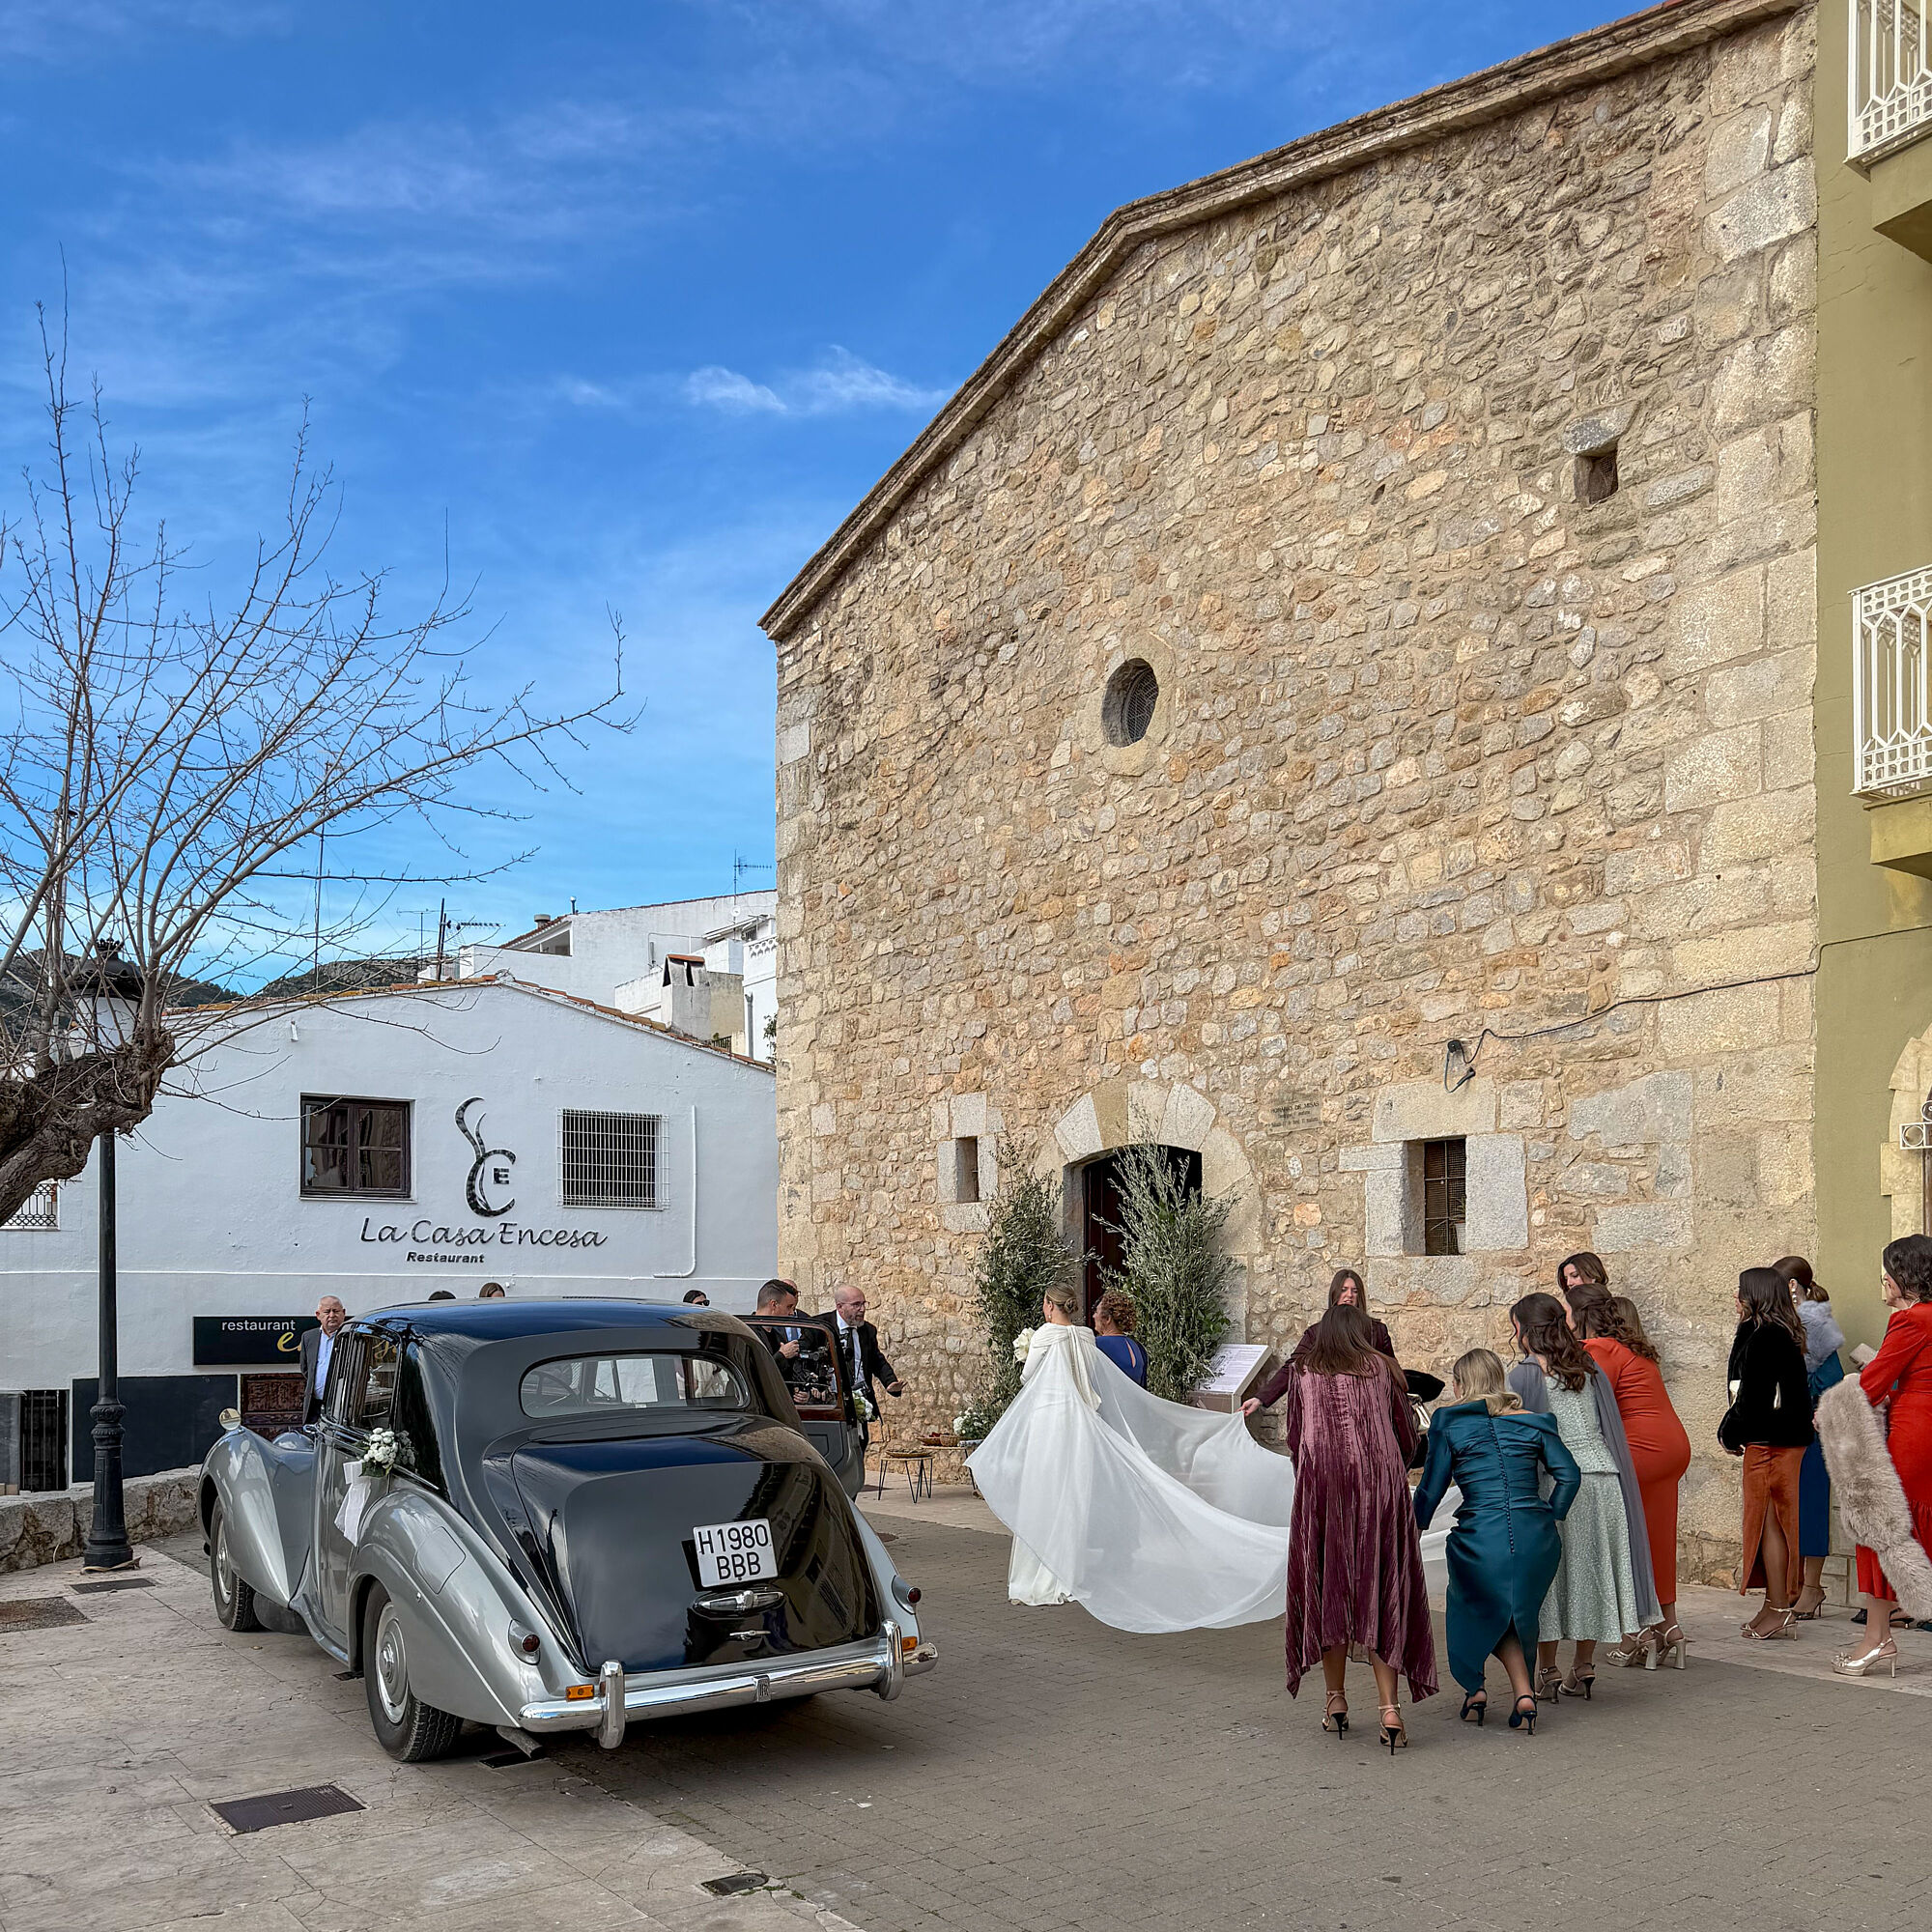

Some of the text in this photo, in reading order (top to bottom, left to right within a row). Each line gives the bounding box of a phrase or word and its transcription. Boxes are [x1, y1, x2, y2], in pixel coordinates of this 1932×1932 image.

[360, 1217, 609, 1248] La Casa Encesa
[406, 1251, 485, 1264] Restaurant
[221, 1320, 297, 1331] restaurant
[716, 1551, 761, 1580] BBB
